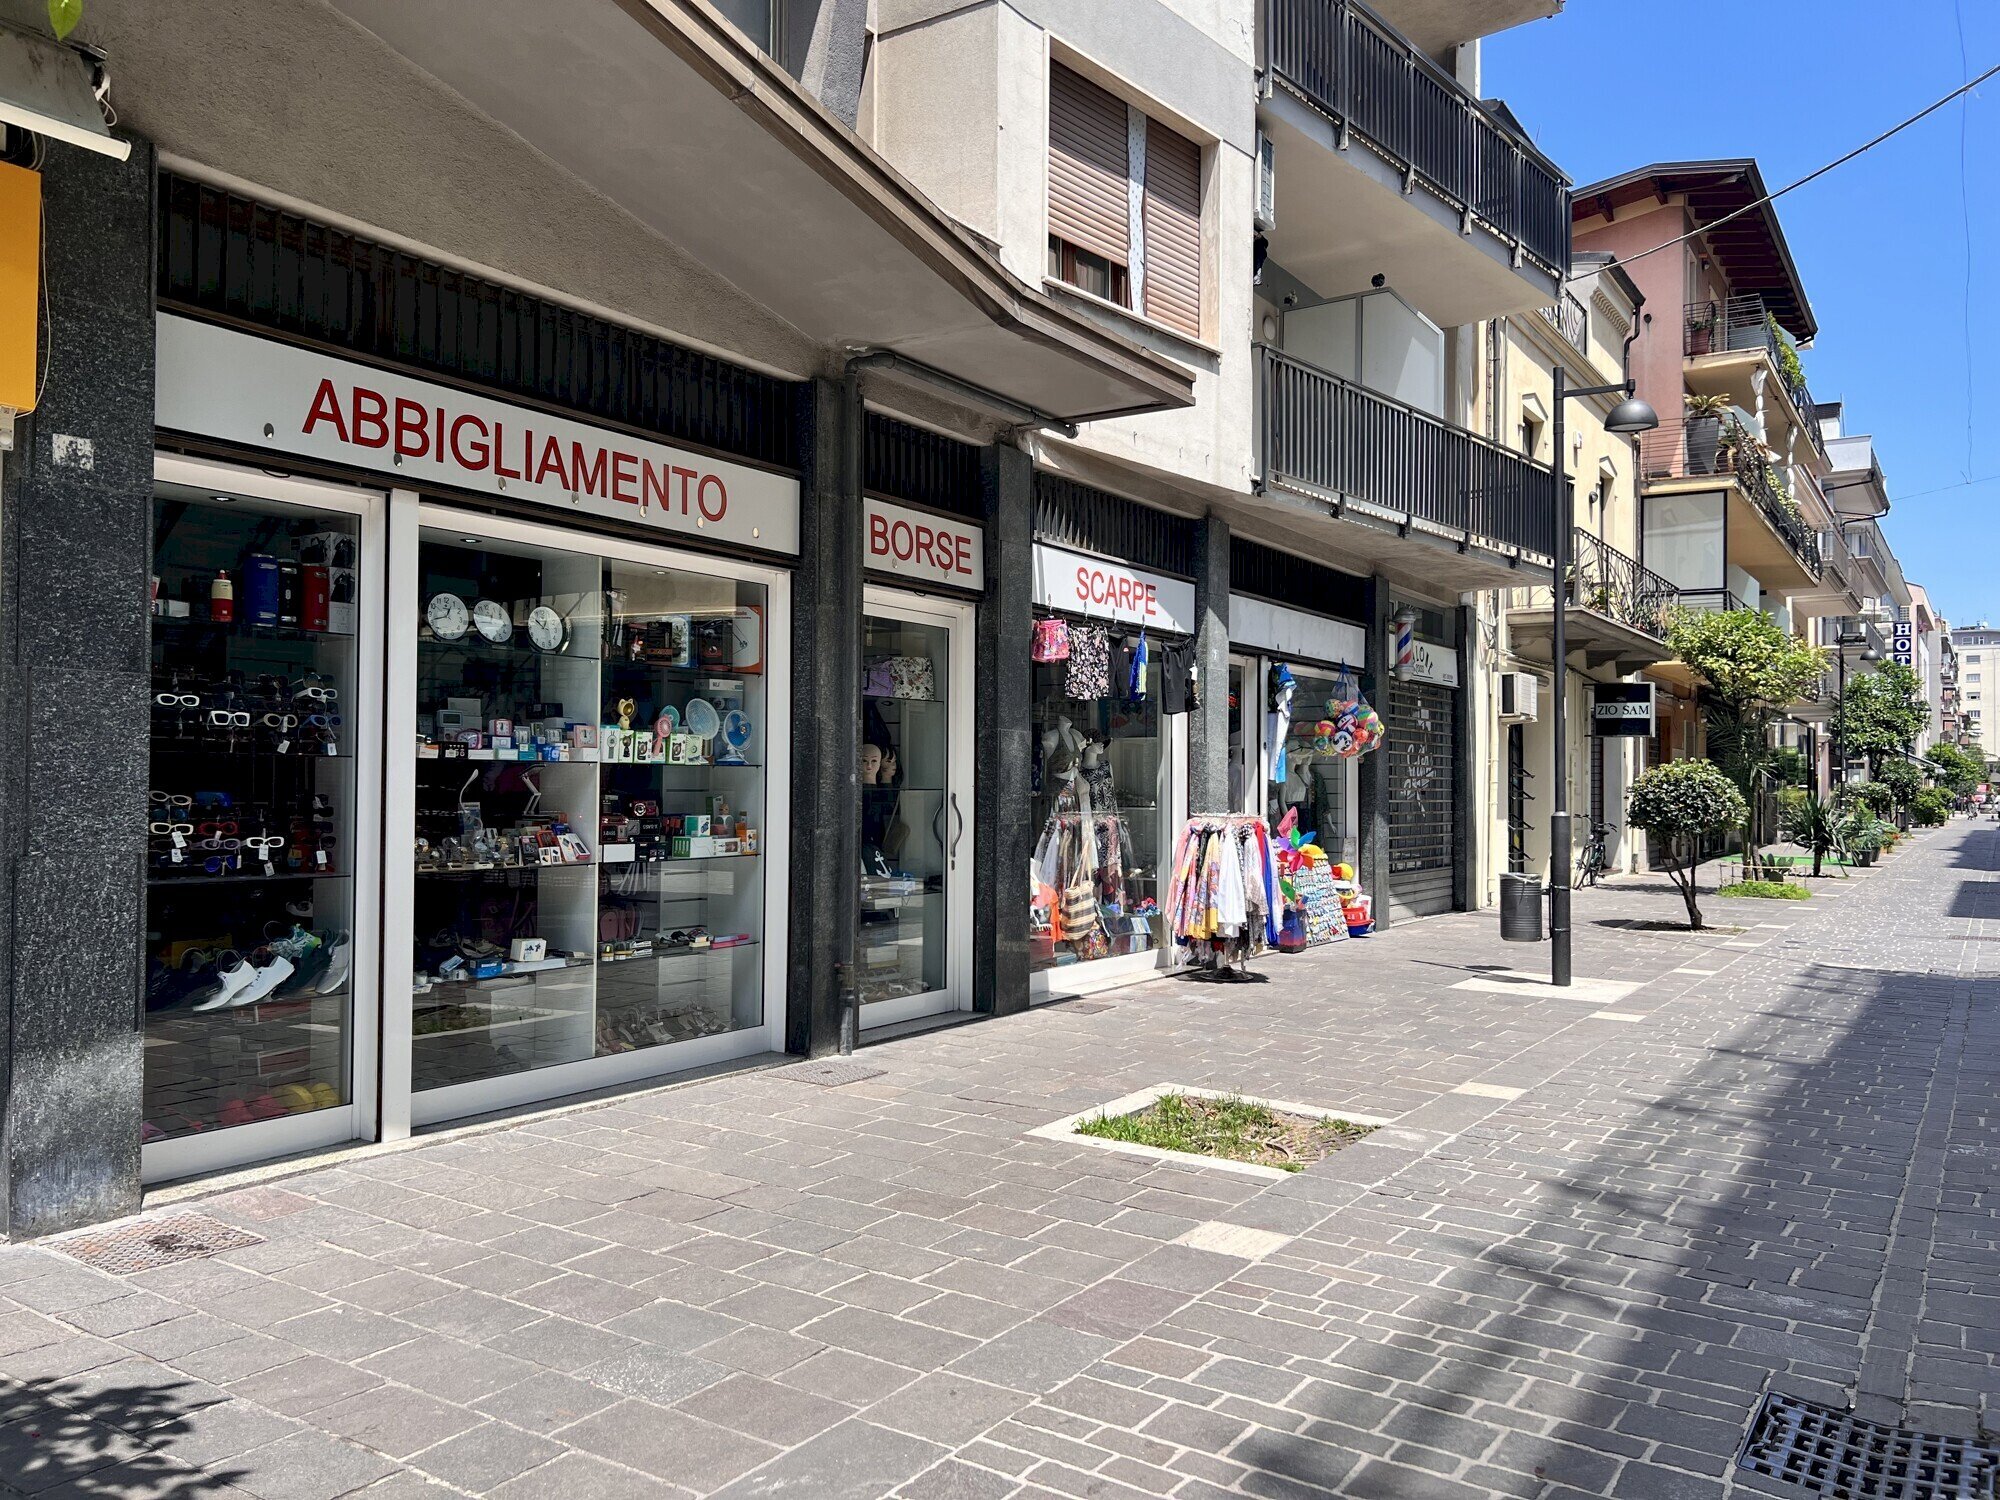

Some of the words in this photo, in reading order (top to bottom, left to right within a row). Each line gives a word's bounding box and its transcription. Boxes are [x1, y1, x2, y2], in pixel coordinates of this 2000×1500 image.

[302, 379, 728, 523] ABBIGLIAMENTO
[870, 514, 972, 575] BORSE
[1075, 566, 1157, 616] SCARPE
[1896, 624, 1911, 665] HOT
[1597, 705, 1618, 715] ZIO
[1622, 705, 1649, 715] SAM
